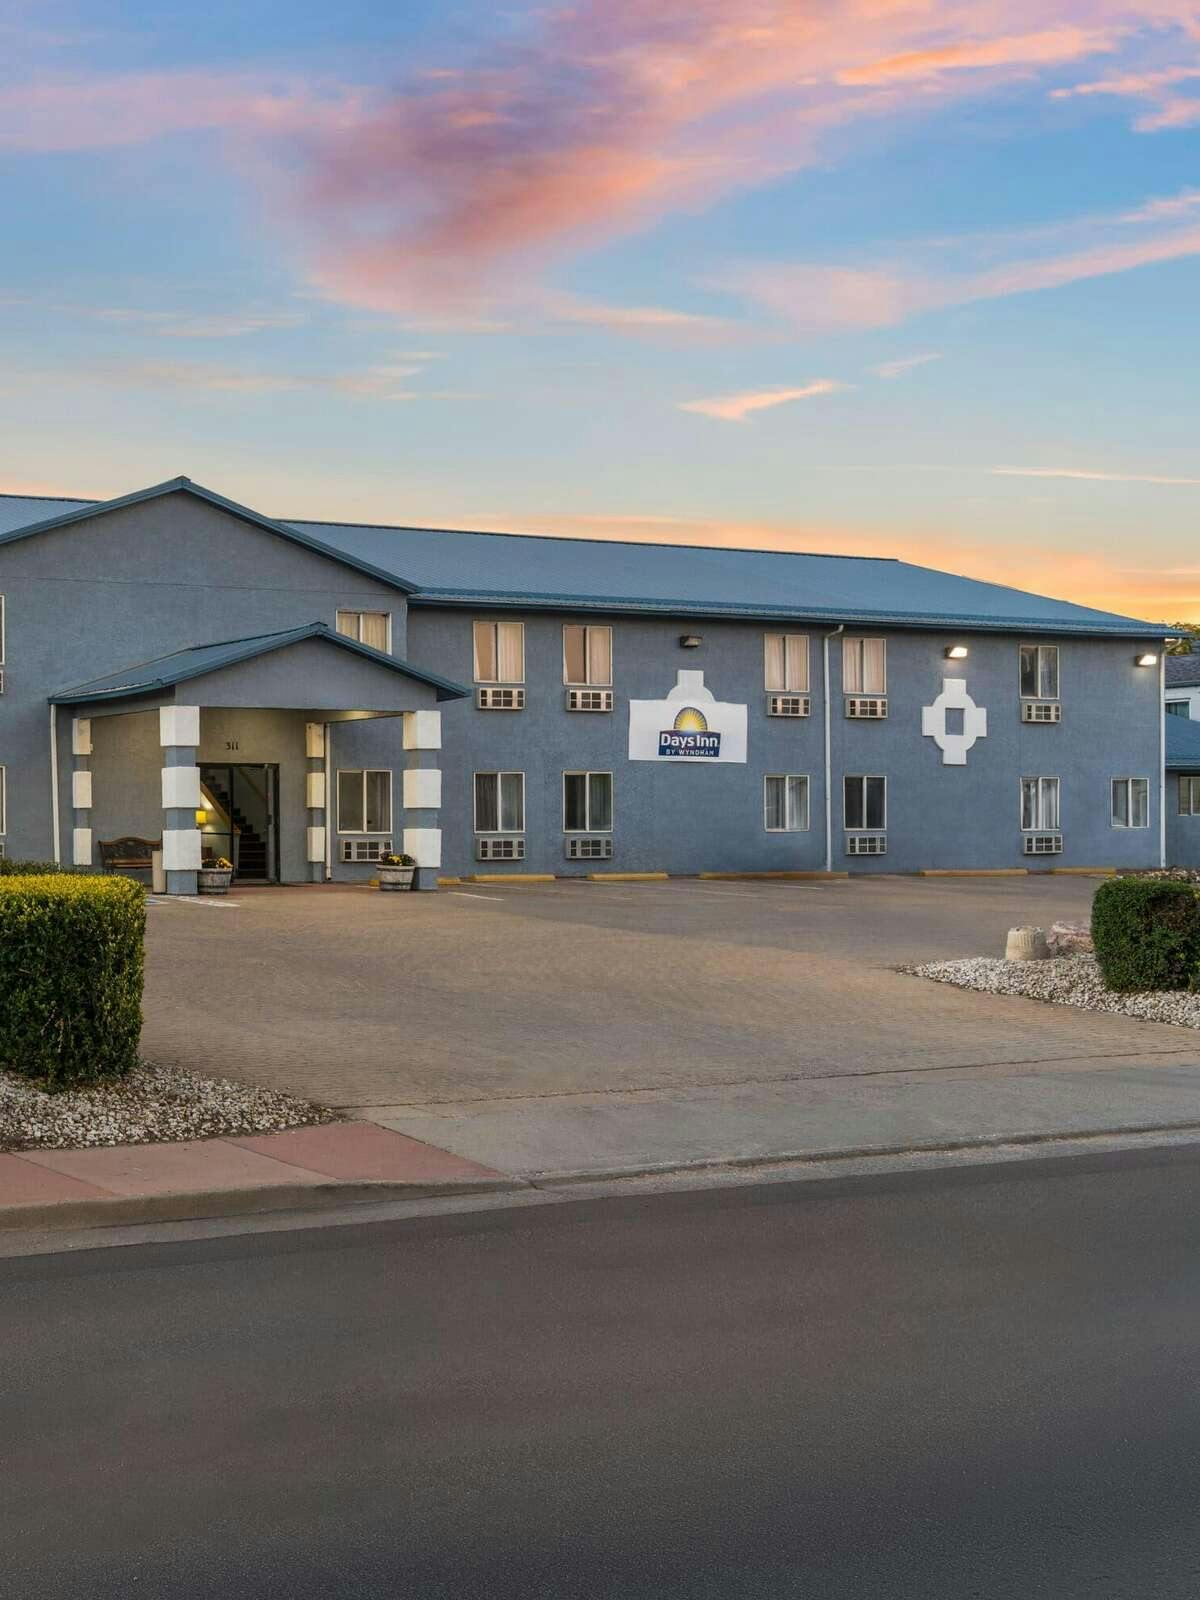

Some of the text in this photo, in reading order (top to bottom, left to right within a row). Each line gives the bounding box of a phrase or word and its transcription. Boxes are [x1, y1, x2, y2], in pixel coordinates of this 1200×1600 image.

[225, 741, 239, 751] 311
[661, 733, 718, 748] Days Inn
